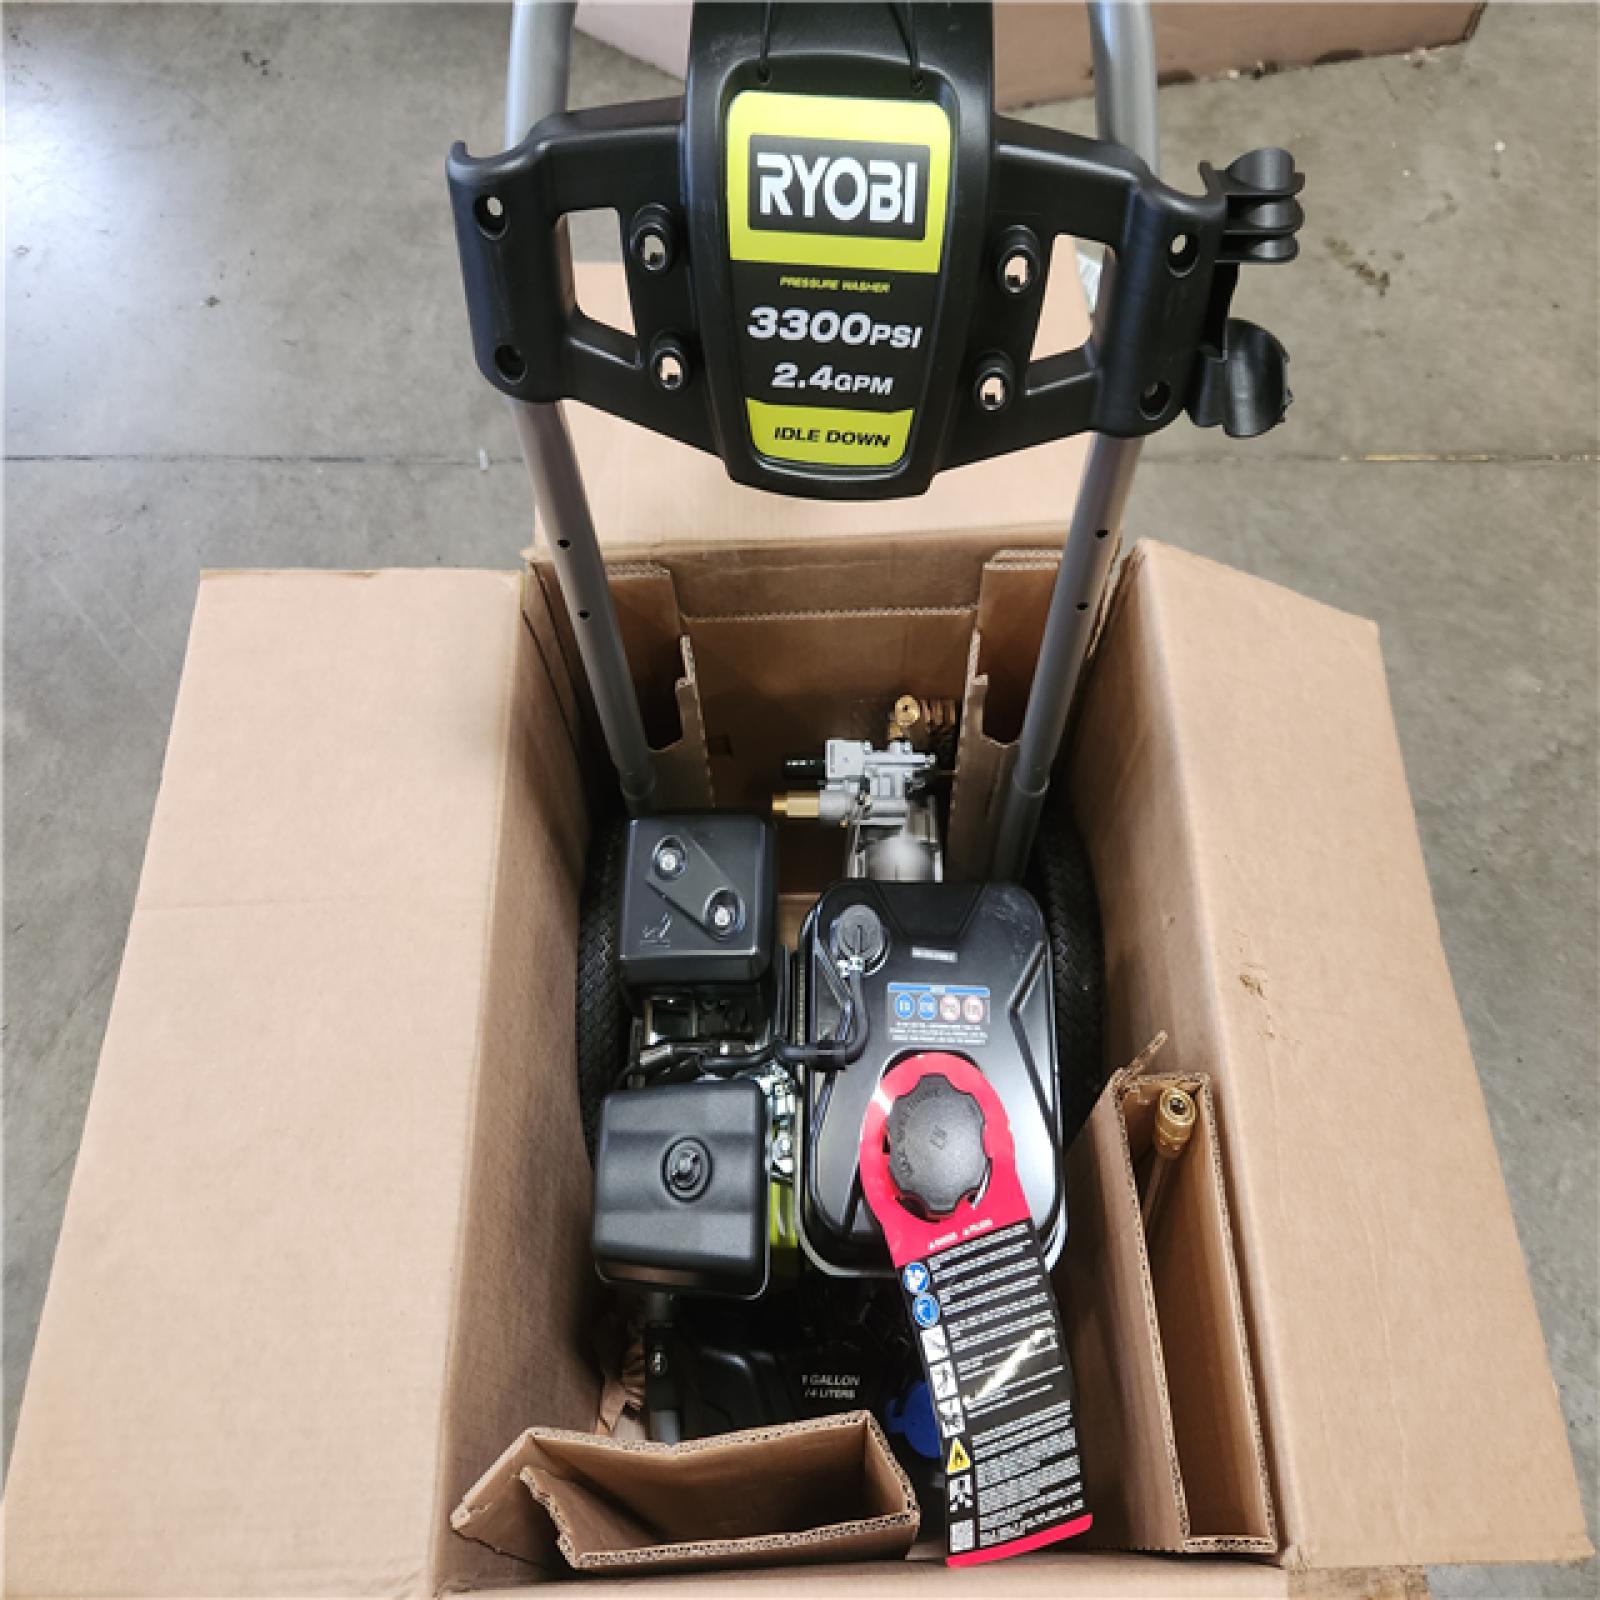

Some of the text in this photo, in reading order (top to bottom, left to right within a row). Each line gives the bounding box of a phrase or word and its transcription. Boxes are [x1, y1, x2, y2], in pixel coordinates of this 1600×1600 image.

[757, 152, 917, 224] RYOBI
[780, 276, 891, 294] PRESSURE WASHER
[747, 306, 923, 349] 3300PSI
[772, 361, 894, 397] 2.4GPM
[774, 427, 891, 447] IDLE DOWN
[810, 1374, 861, 1386] GALLON
